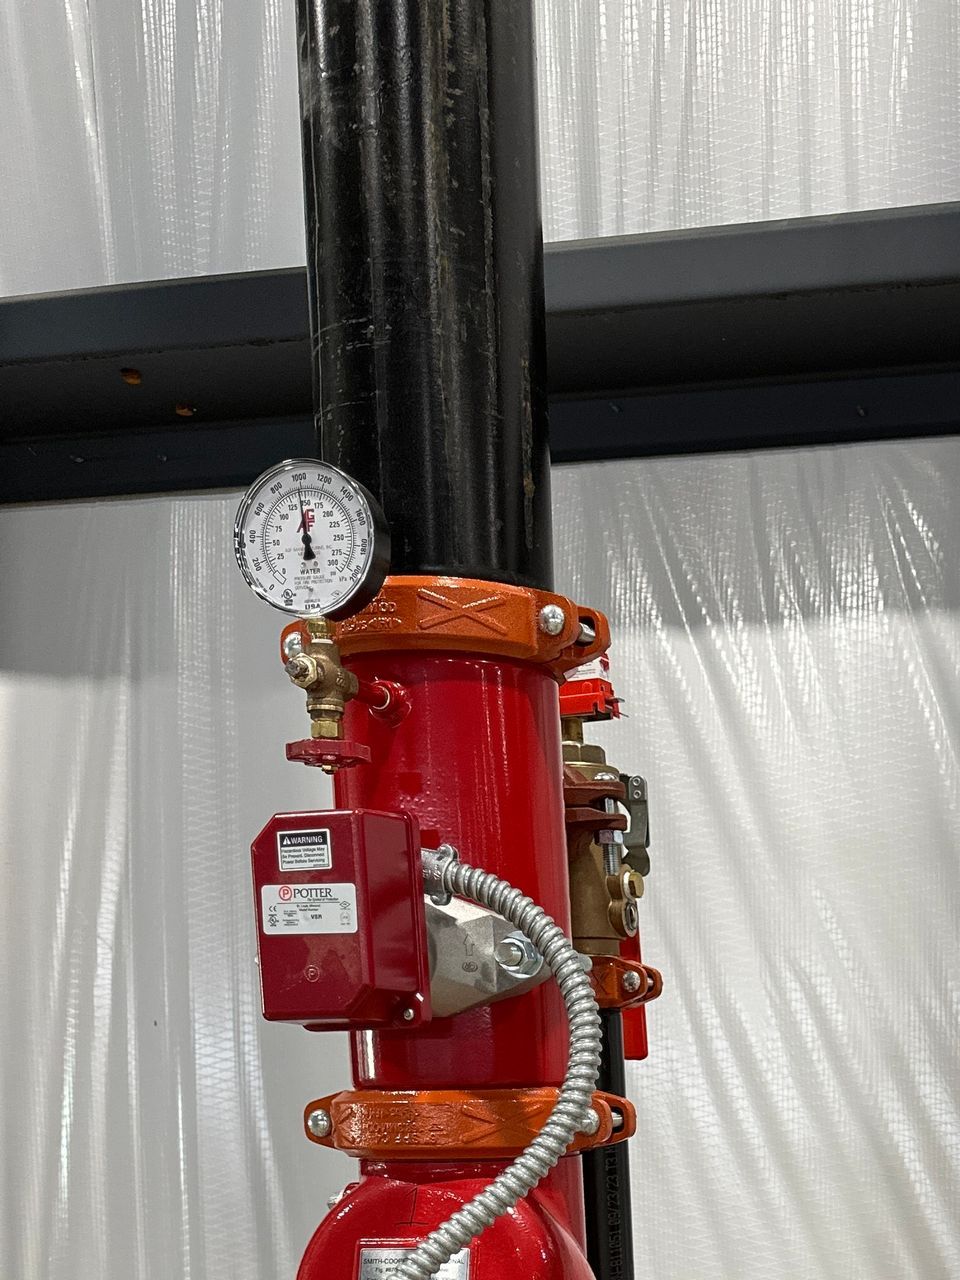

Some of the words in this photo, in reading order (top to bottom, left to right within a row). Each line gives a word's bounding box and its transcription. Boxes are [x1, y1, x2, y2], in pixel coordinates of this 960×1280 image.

[292, 473, 306, 482] 1000
[317, 474, 332, 484] 1200
[270, 482, 283, 494] 800
[340, 486, 354, 502] 1400
[254, 502, 265, 517] 600
[355, 508, 366, 526] 1600
[249, 530, 257, 544] 400
[360, 538, 368, 555] 1800
[252, 557, 262, 572] 200
[350, 565, 362, 582] 2000
[291, 836, 323, 844] WARNING
[293, 888, 333, 899] POTTER
